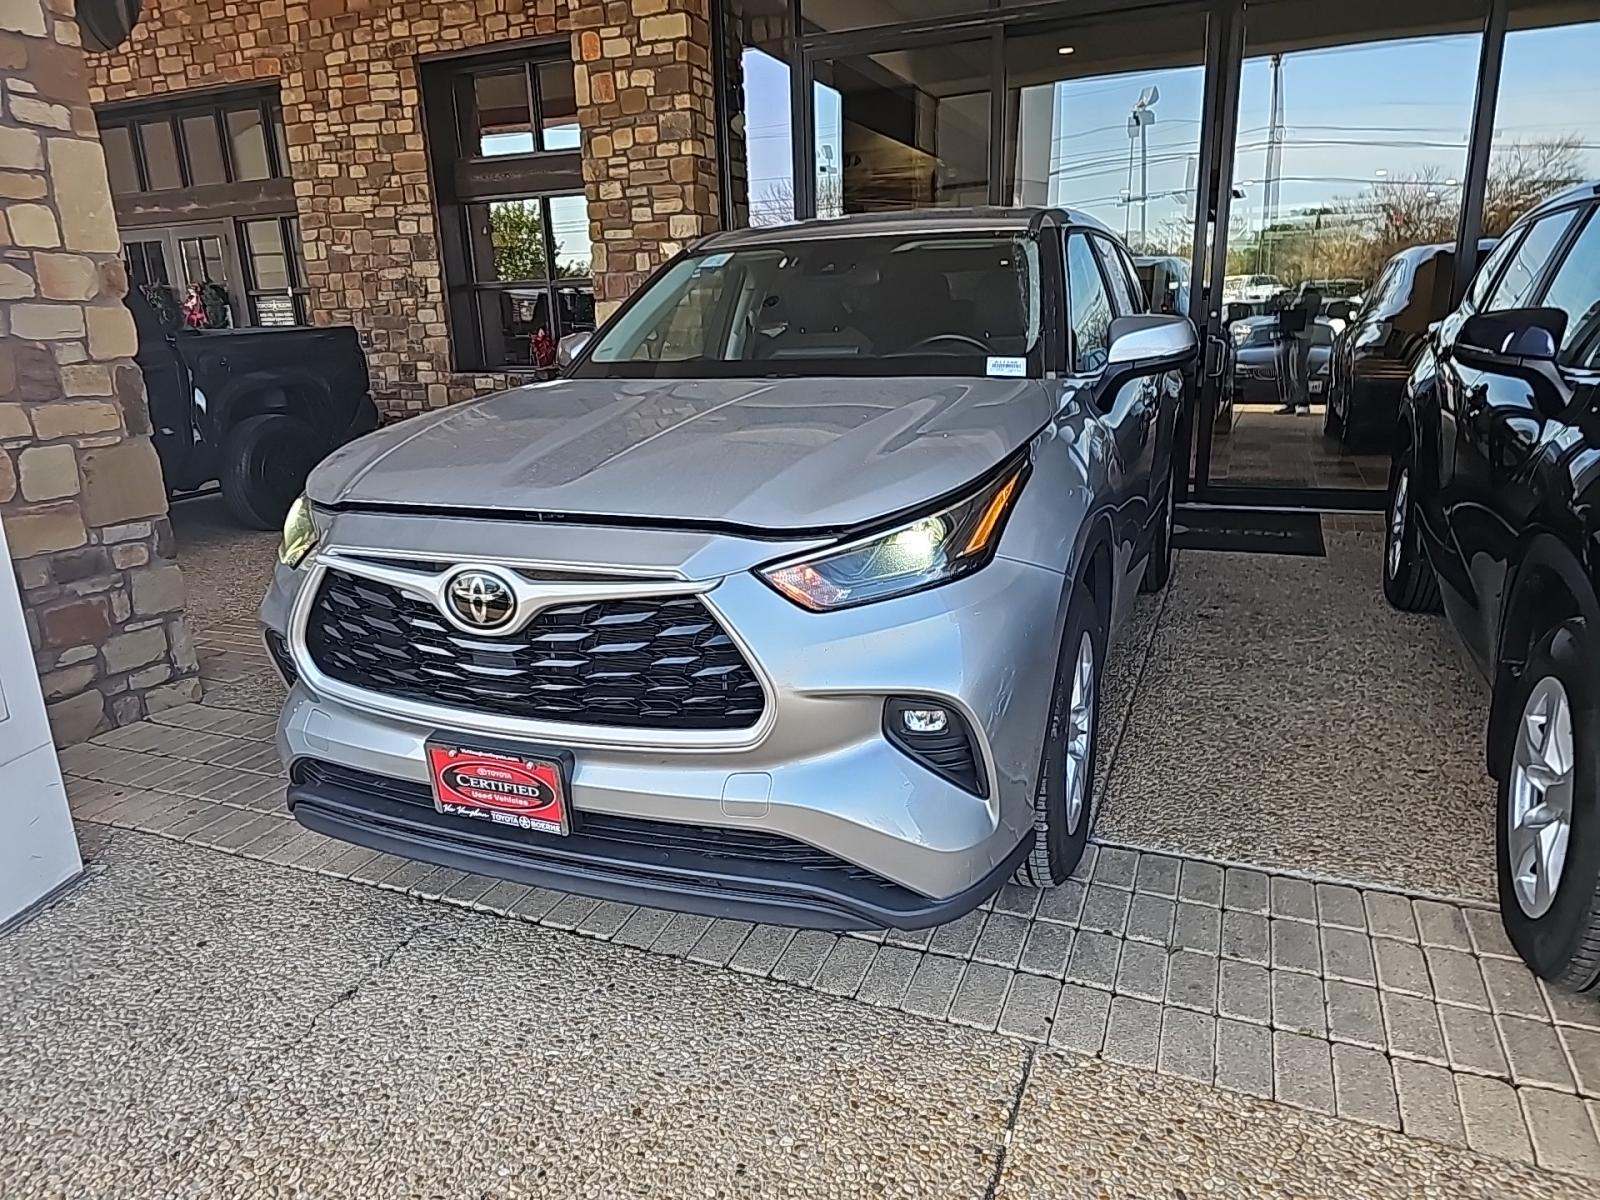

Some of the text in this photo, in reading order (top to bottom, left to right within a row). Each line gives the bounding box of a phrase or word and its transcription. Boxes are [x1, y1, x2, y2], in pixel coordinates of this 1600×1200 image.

[487, 769, 512, 780] TOYOTA
[456, 774, 540, 797] CERTIFIED
[471, 790, 529, 807] Used Vehicles
[491, 812, 519, 825] TOYOTA
